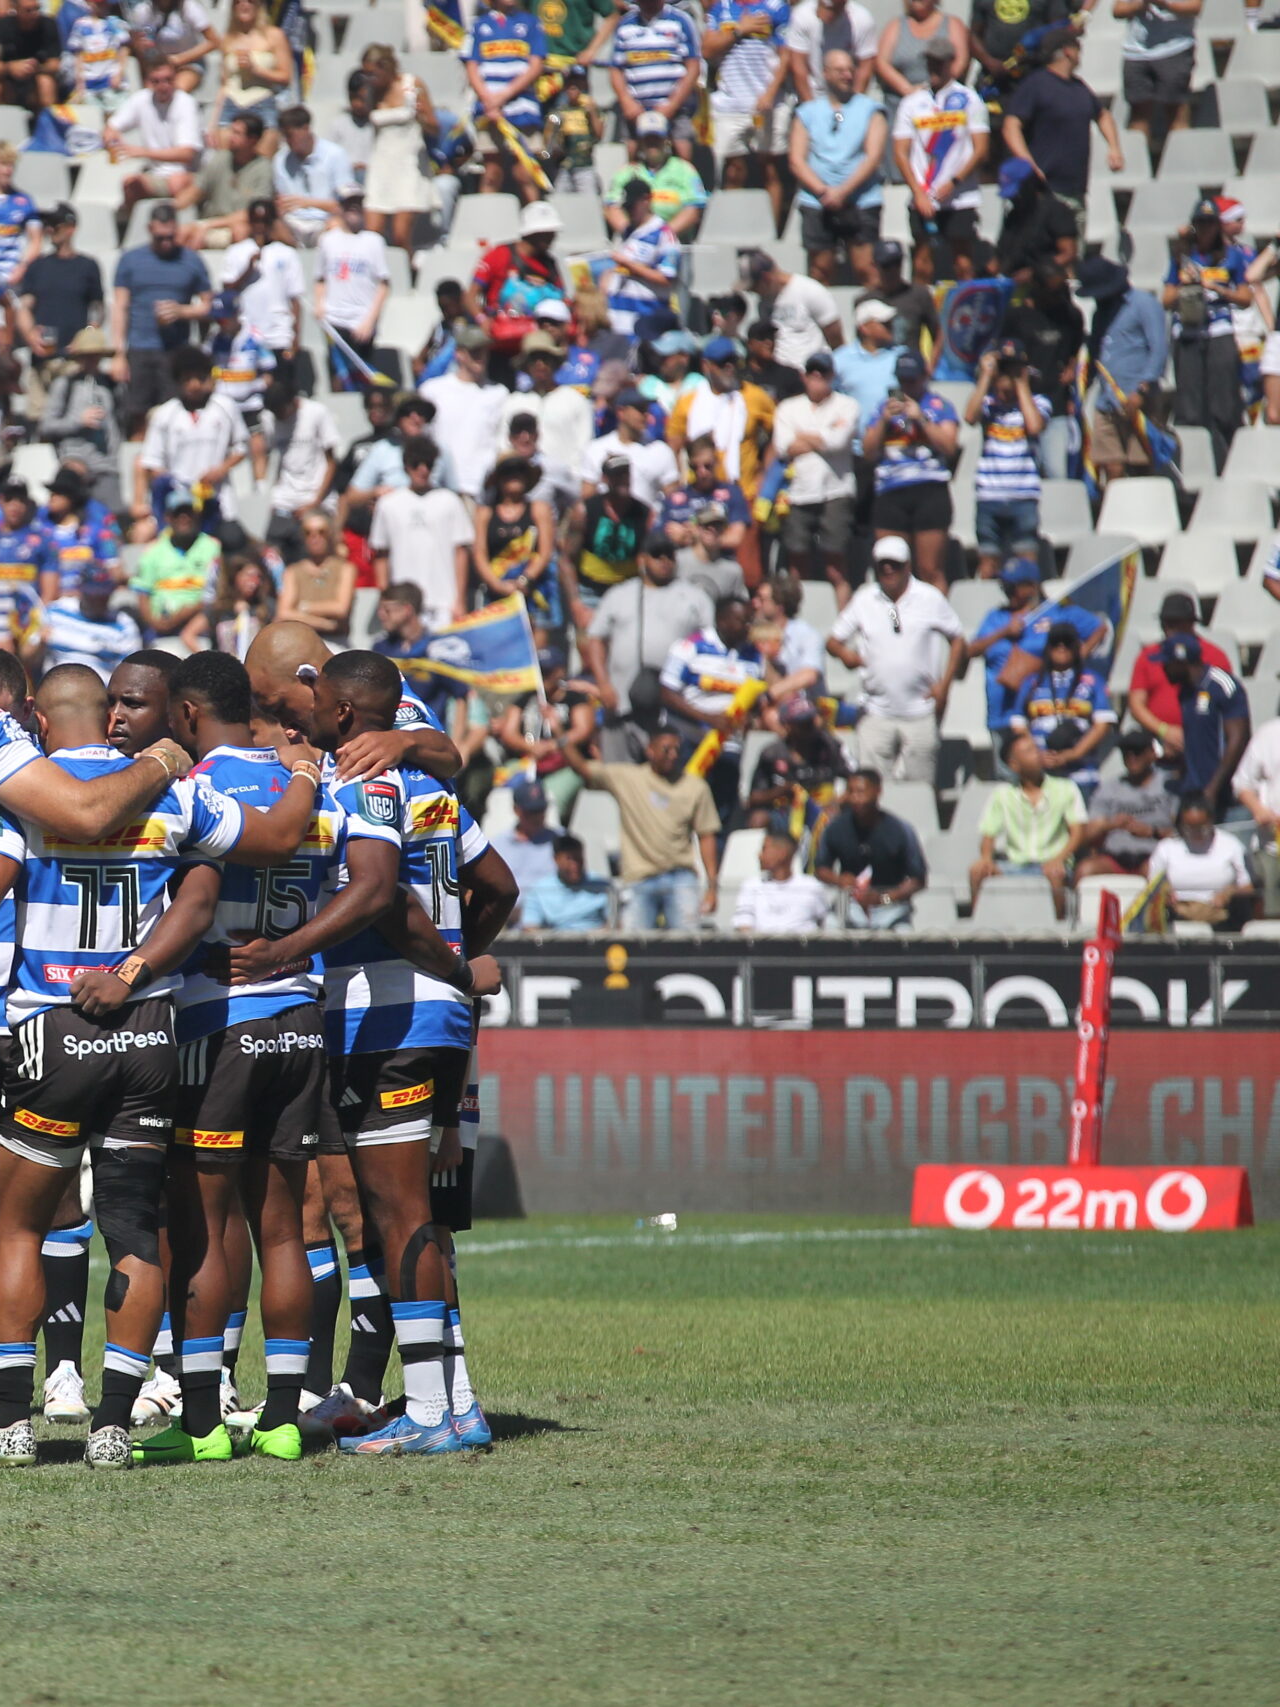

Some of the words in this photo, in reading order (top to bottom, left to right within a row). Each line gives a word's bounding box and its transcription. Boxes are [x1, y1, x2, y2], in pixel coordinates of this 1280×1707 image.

[61, 864, 140, 950] 11
[254, 859, 312, 941] 15
[46, 966, 72, 981] SIX
[63, 1030, 169, 1060] SportPesa
[239, 1031, 324, 1059] SportPesa
[391, 1084, 433, 1105] DHL
[22, 1112, 70, 1135] DHL
[534, 1072, 820, 1173] UNITED
[1149, 1075, 1280, 1168] CH
[186, 1133, 234, 1145] DHL
[1012, 1177, 1139, 1230] 22m
